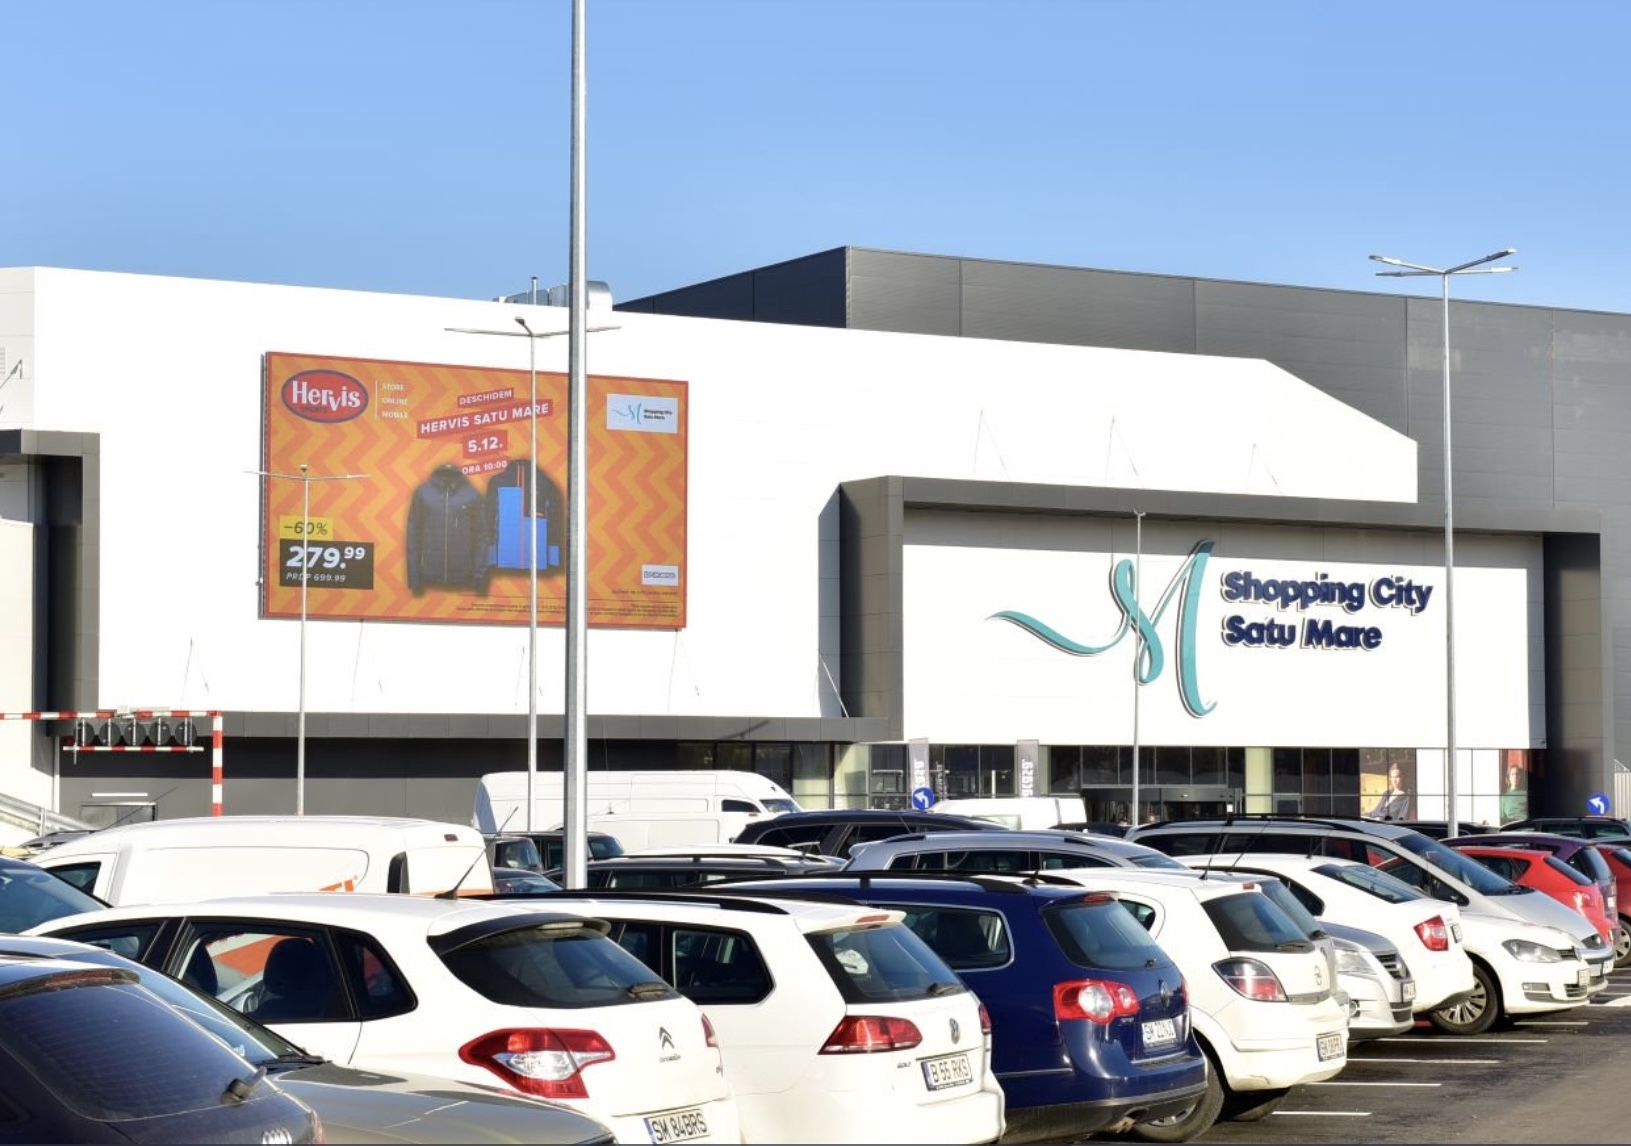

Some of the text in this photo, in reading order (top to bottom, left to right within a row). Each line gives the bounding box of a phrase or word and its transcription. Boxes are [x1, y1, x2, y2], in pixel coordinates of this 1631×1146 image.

[292, 380, 361, 412] Hervis
[459, 389, 512, 405] DESCHIDEM
[421, 402, 549, 434] HERVIS SATU MARE
[467, 436, 503, 453] 5.12.
[461, 460, 508, 475] ORA 10:00
[1224, 571, 1434, 614] Shopping City
[1225, 615, 1383, 649] Satu Mare
[930, 1063, 940, 1083] B
[652, 1118, 672, 1142] SM
